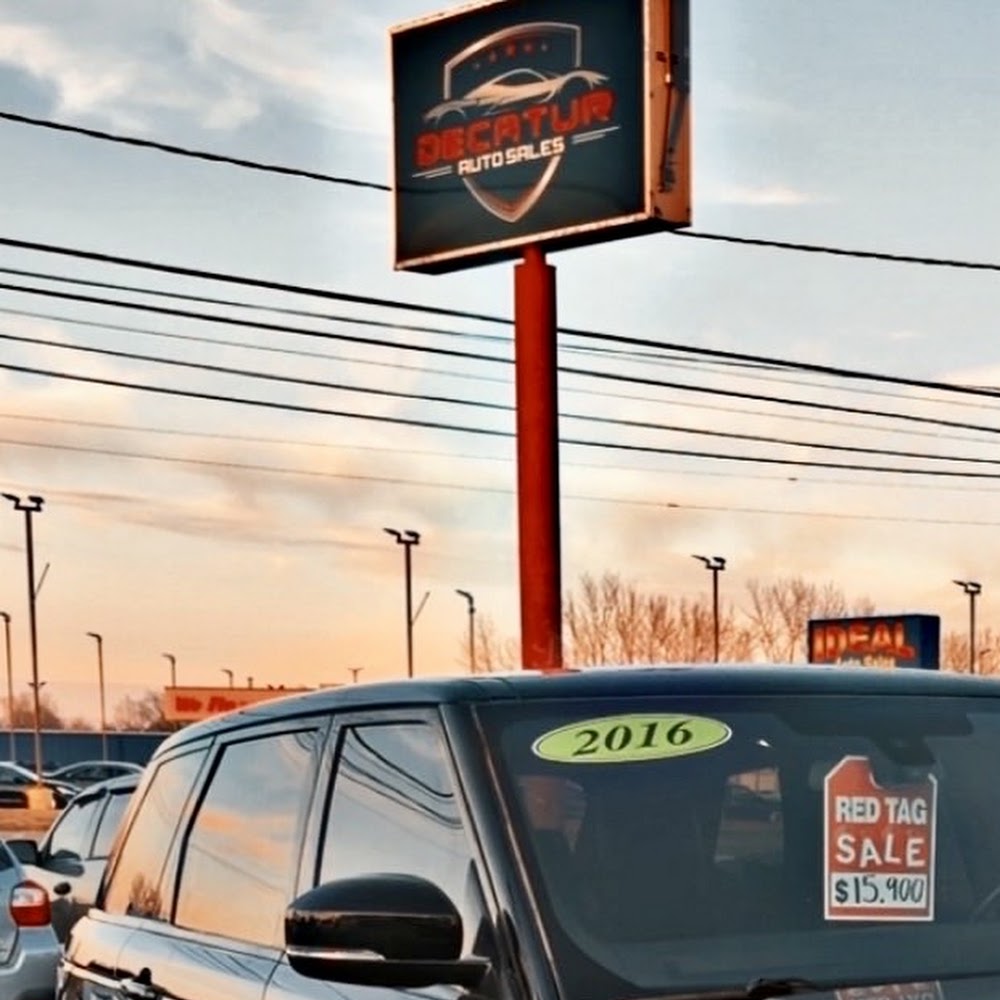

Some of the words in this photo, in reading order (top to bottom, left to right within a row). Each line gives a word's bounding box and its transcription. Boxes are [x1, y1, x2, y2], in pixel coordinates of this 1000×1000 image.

[416, 90, 616, 167] DECATUR
[458, 151, 504, 175] AUTO
[505, 136, 565, 165] SALES
[814, 621, 915, 663] IDEAL
[572, 719, 693, 756] 2016
[835, 796, 881, 823] RED
[884, 797, 928, 825] TAG
[836, 834, 926, 868] SALE
